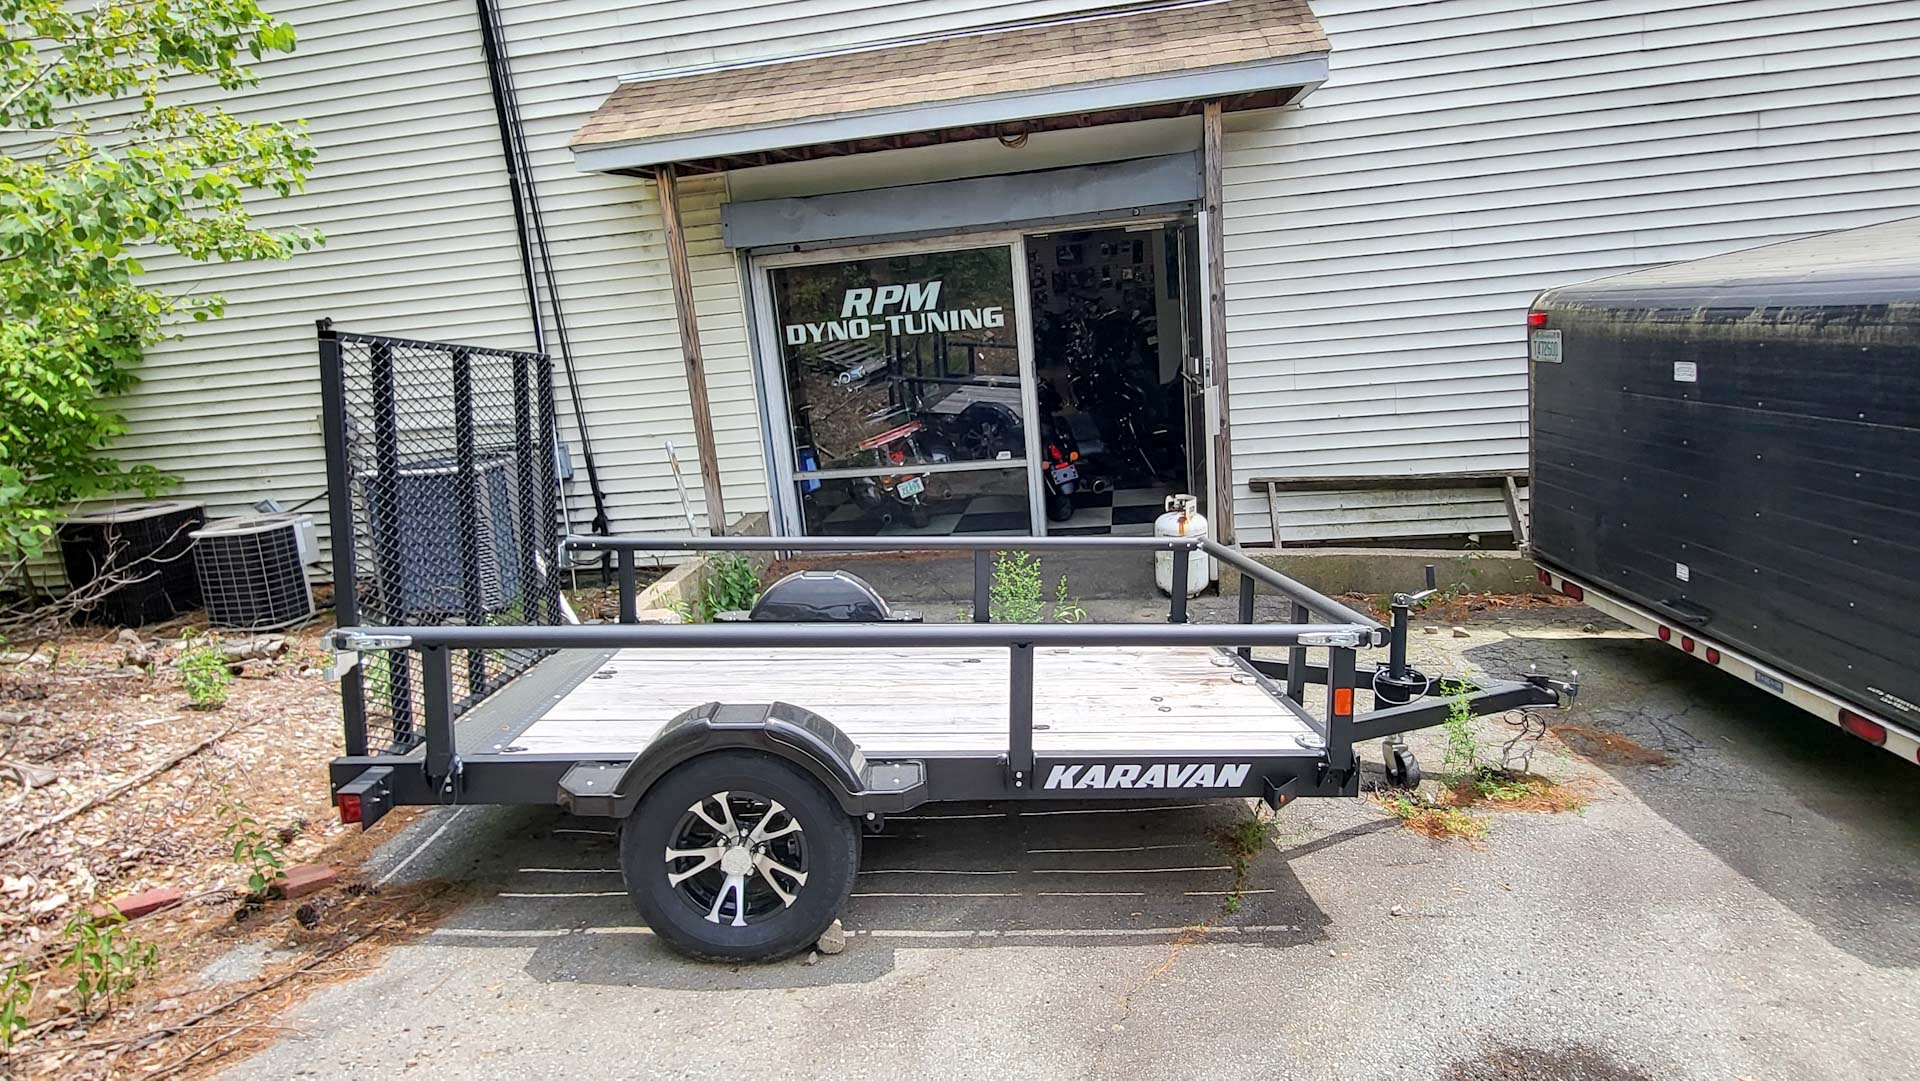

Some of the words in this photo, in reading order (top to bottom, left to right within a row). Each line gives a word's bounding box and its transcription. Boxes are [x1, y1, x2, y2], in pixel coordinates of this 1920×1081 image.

[840, 281, 942, 318] RPM
[786, 307, 1004, 345] DYNO-TUNING
[1044, 764, 1251, 789] KARAVAN
